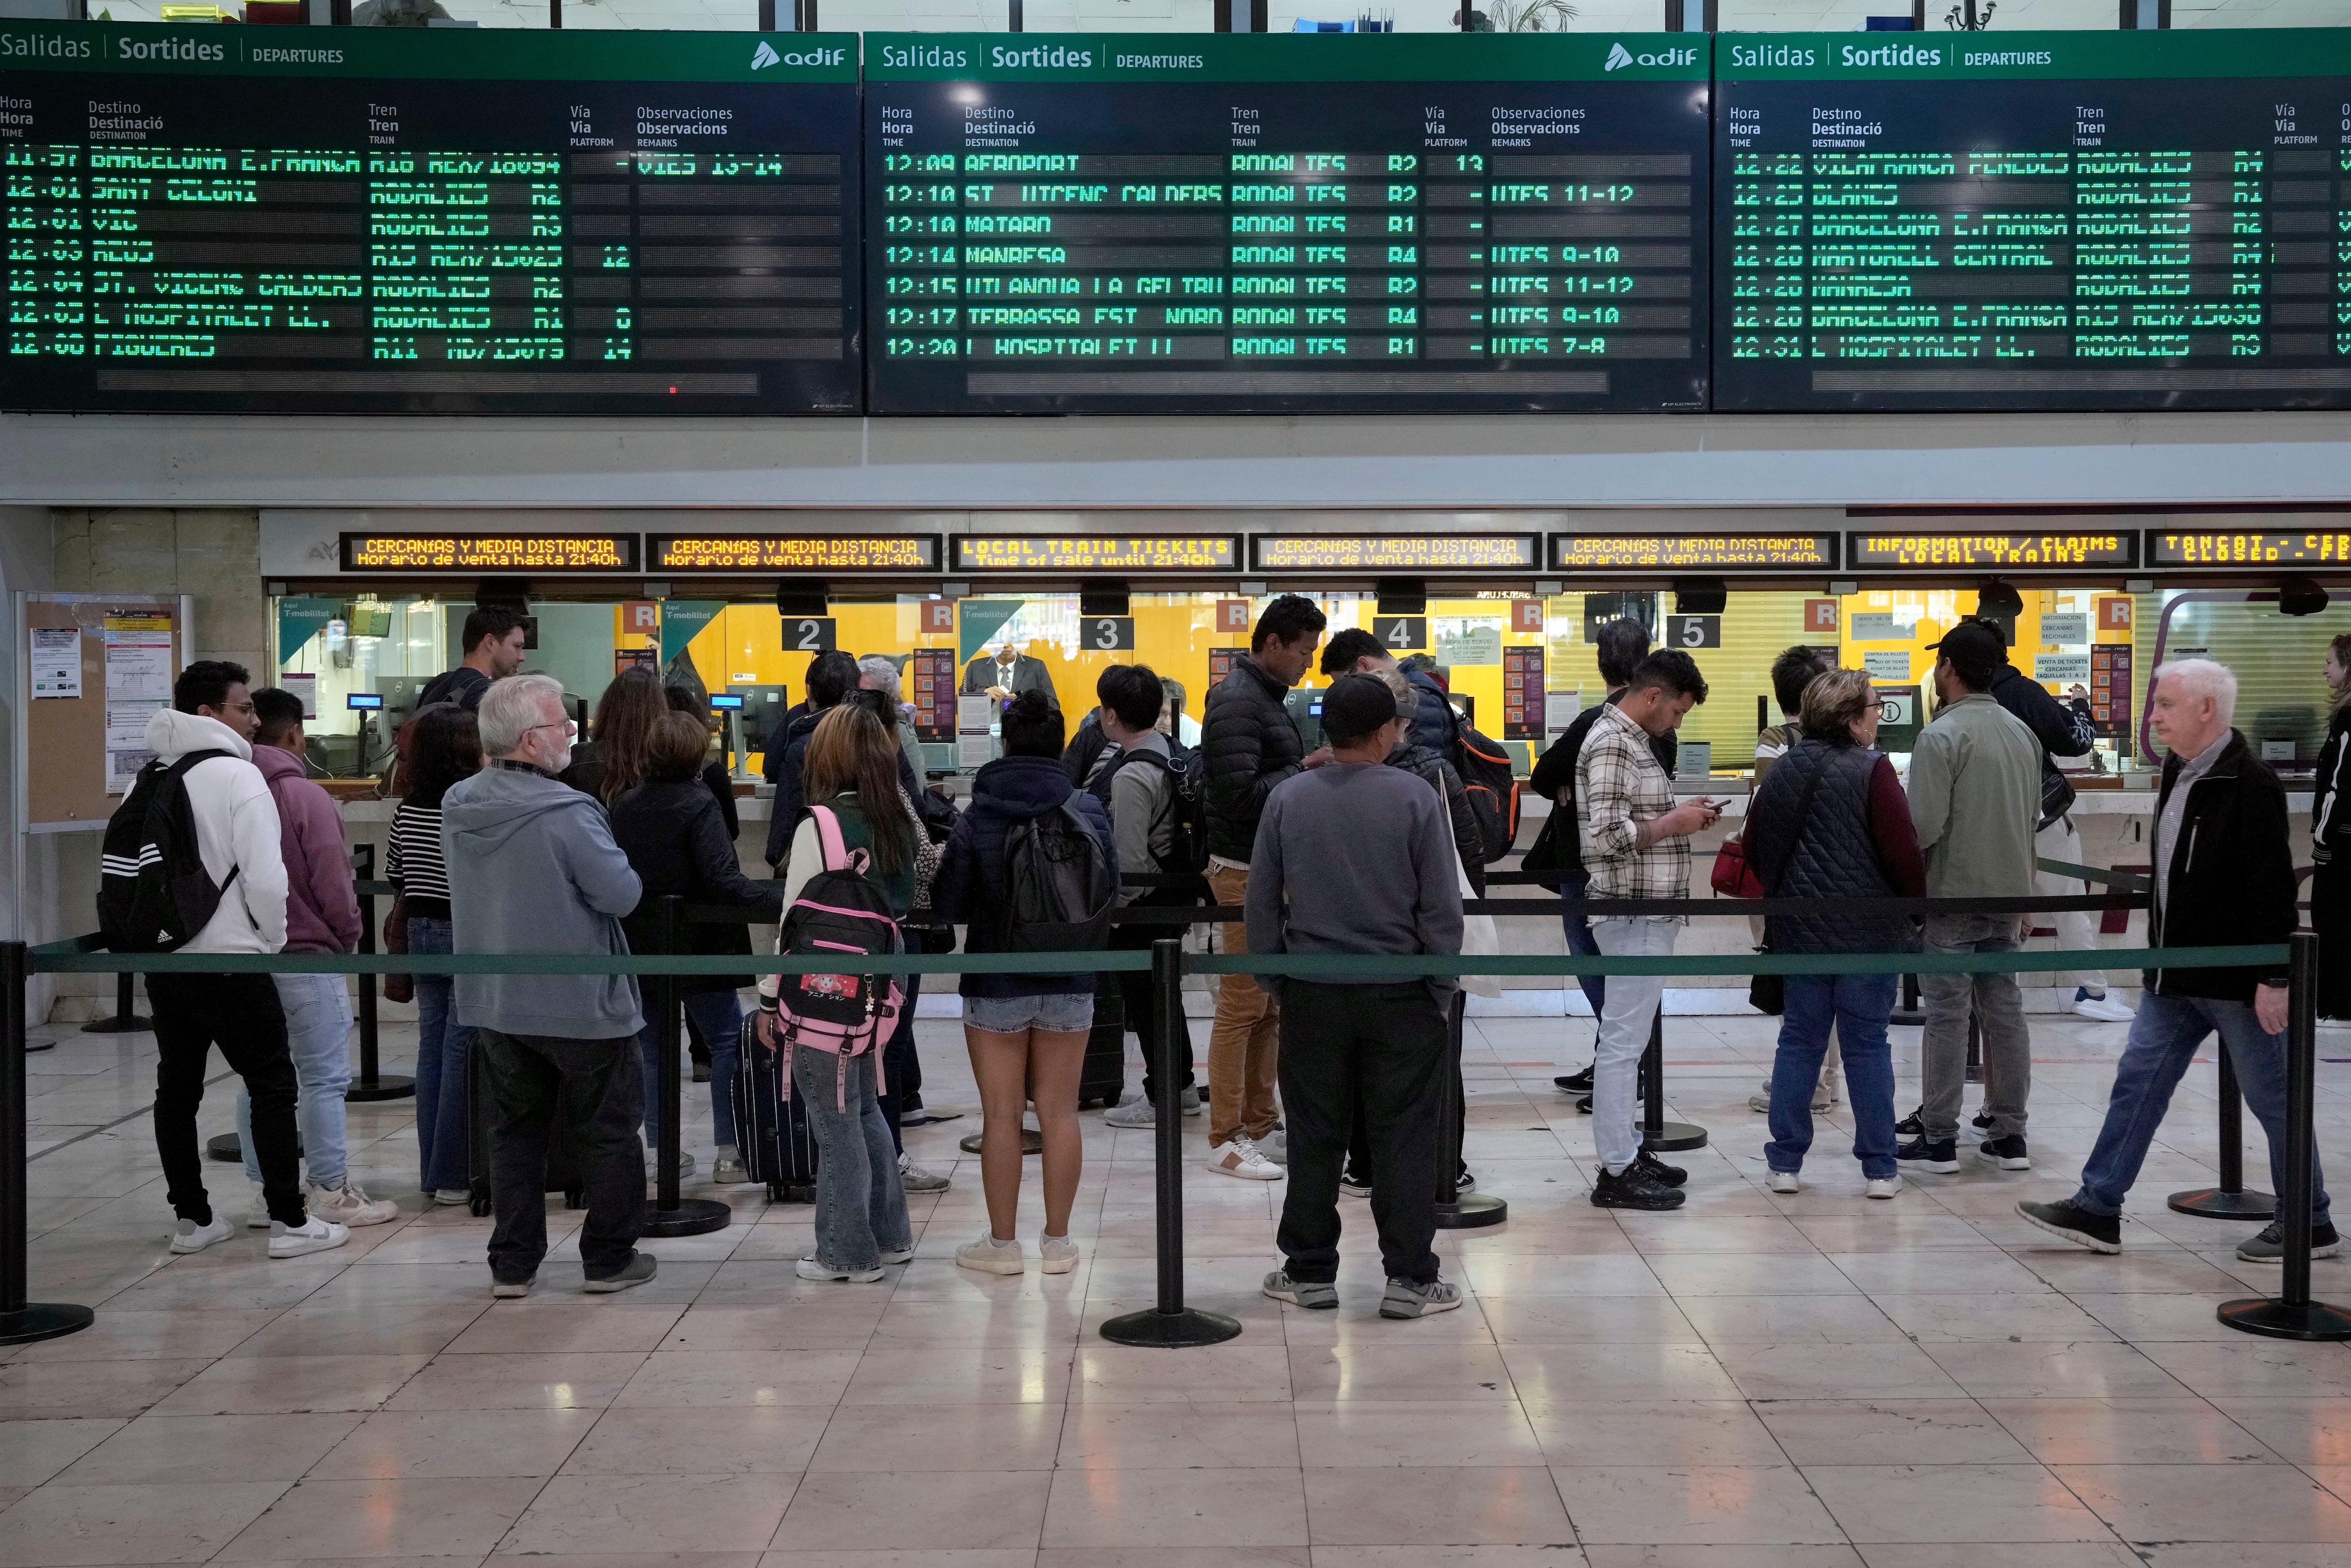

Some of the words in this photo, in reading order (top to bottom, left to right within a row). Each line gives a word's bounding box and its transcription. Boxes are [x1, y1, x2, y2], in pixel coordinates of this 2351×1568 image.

[1, 34, 90, 57] Salidas
[119, 37, 223, 60] Sortides
[253, 49, 343, 63] DEPARTURES
[1733, 45, 1814, 66] Salidas
[1842, 44, 1941, 66] Sortides
[1965, 52, 2051, 65] DEPARTURES
[784, 48, 845, 65] adif
[884, 46, 966, 67] Salidas
[993, 45, 1091, 67] Sortides
[1117, 55, 1203, 68] DEPARTURES
[1638, 48, 1697, 65] adif
[0, 96, 31, 109] Hora
[89, 101, 140, 113] Destino
[369, 104, 396, 116] Tren
[571, 105, 590, 118] Vía
[638, 107, 732, 119] Observaciones
[883, 107, 911, 118] Hora
[965, 107, 1014, 118] Destino
[1231, 107, 1258, 118] Tren
[1426, 106, 1444, 118] Vía
[1492, 107, 1585, 118] Observaciones
[1731, 107, 1759, 119] Hora
[1813, 108, 1861, 119] Destino
[2076, 107, 2103, 118] Tren
[2276, 103, 2295, 116] Vía
[0, 112, 33, 124] Hora
[89, 116, 163, 129] Destinació
[369, 119, 398, 131] Tren
[570, 120, 591, 133] Via
[637, 122, 727, 134] Observacions
[883, 122, 913, 134] Hora
[965, 121, 1035, 134] Destinació
[1231, 122, 1260, 134] Tren
[1425, 121, 1445, 134] Via
[1492, 121, 1580, 134] Observacions
[1730, 123, 1760, 134] Hora
[1813, 122, 1882, 134] Destinació
[2076, 122, 2105, 133] Tren
[2275, 119, 2295, 131] Via
[460, 541, 471, 552] Y
[476, 540, 523, 553] MEDIA
[528, 540, 614, 553] DISTANCIA
[765, 541, 776, 552] Y
[781, 541, 827, 554] MEDIA
[831, 540, 916, 554] DISTANCIA
[963, 541, 1033, 554] LOCAL
[1048, 540, 1116, 553] TRAIN
[1130, 540, 1227, 553] TICKETS
[1366, 540, 1377, 552] Y
[1382, 539, 1427, 552] MEDIA
[1432, 539, 1516, 553] DISTANCIA
[1869, 537, 2011, 552] INFORMATION
[2042, 537, 2116, 551] CLAIMS
[358, 553, 428, 565] Horario
[434, 555, 454, 565] de
[459, 553, 510, 565] venta
[513, 553, 565, 565] hasta
[570, 553, 621, 565] 21:40h
[664, 553, 734, 565] Horario
[740, 553, 757, 564] de
[764, 553, 814, 564] venta
[818, 553, 868, 565] hasta
[874, 553, 923, 566] 21:40h
[976, 554, 1018, 566] Time
[1027, 555, 1046, 566] of
[1055, 555, 1093, 566] sale
[1101, 555, 1145, 566] until
[1154, 555, 1215, 566] 21:40h
[1899, 550, 1975, 563] LOCAL
[1992, 550, 2085, 563] TRAINS
[2184, 547, 2278, 561] CLOSED
[636, 607, 655, 626] R
[934, 606, 952, 625] R
[1229, 605, 1247, 624] R
[1524, 605, 1542, 624] R
[1817, 605, 1835, 624] R
[2112, 603, 2130, 622] R
[798, 620, 820, 649] 2
[1097, 619, 1118, 649] 3
[1389, 619, 1411, 648] 4
[1682, 617, 1704, 647] 5
